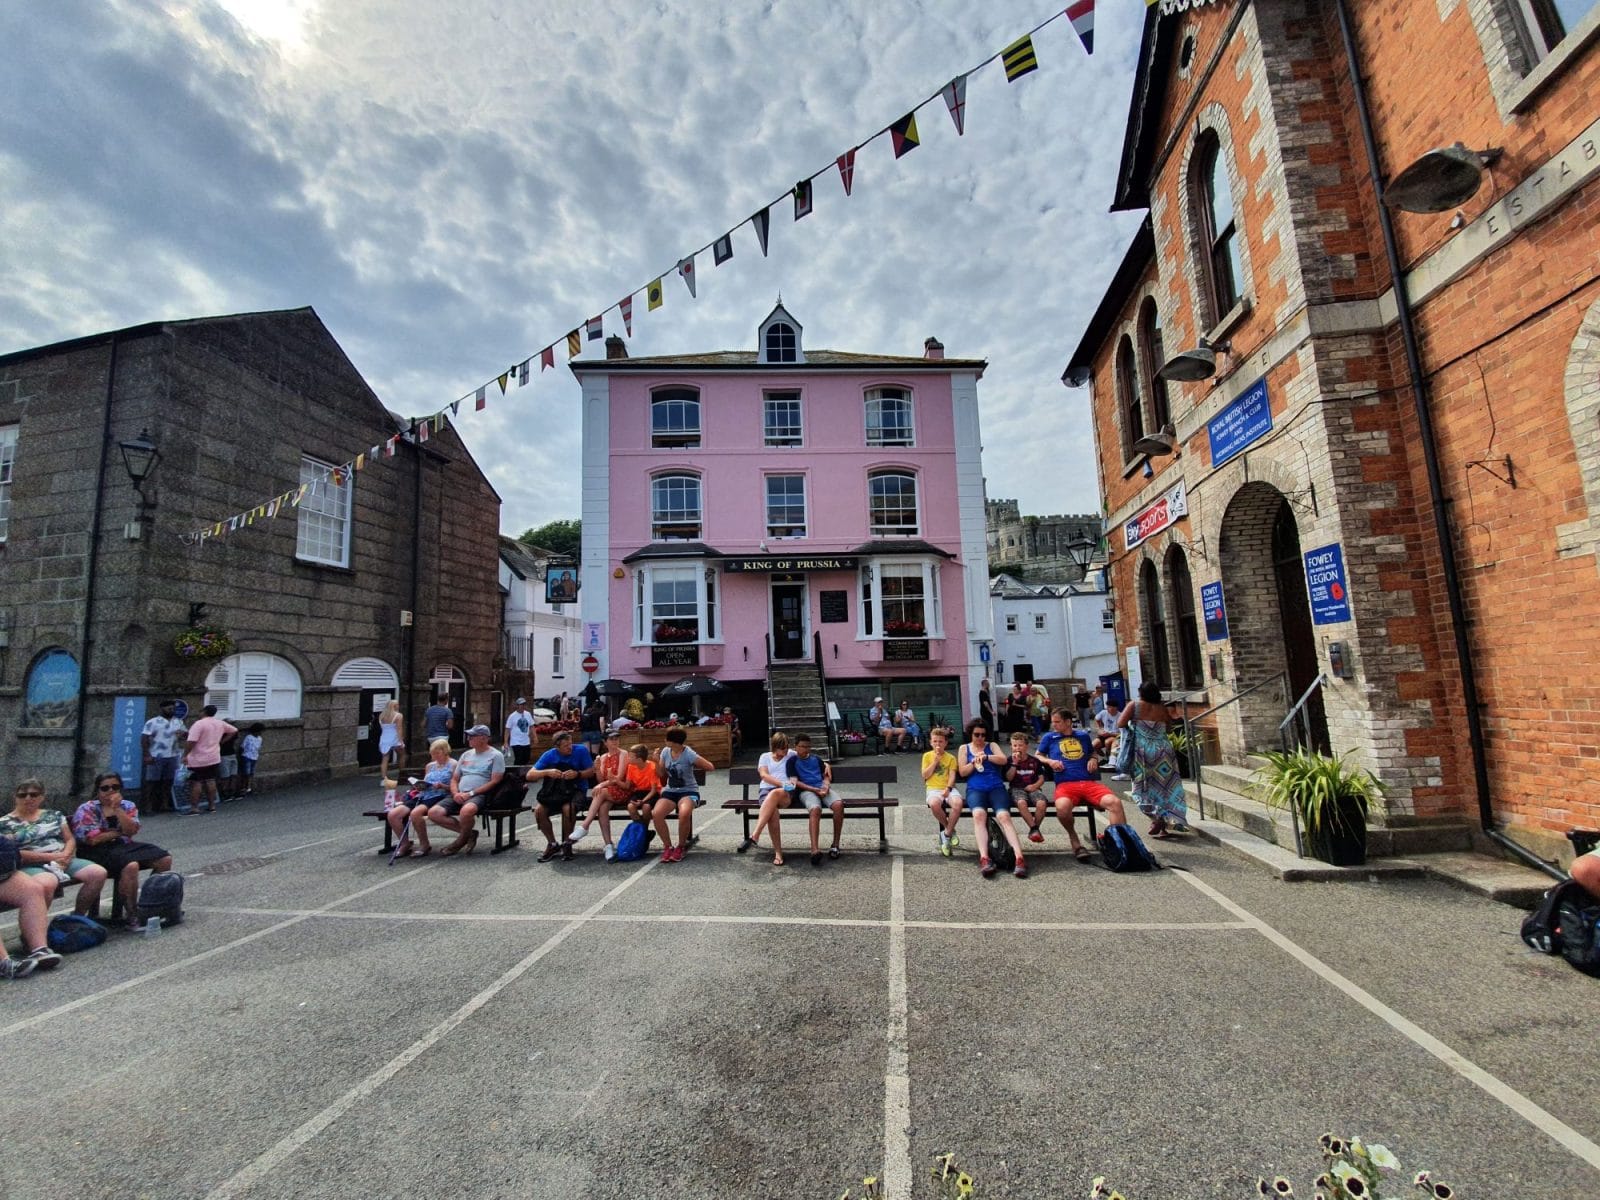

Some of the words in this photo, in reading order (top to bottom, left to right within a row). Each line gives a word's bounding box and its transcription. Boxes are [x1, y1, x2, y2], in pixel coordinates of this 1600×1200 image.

[1212, 418, 1225, 434] ROYAL
[1225, 405, 1243, 423] BRITISH
[1243, 388, 1263, 409] LEGION
[1229, 415, 1246, 432] BRANCH
[1249, 403, 1262, 416] CLUB
[1234, 427, 1243, 436] AND
[1246, 418, 1267, 437] INSTITUTE
[1128, 524, 1139, 540] sky
[1139, 506, 1165, 534] sports
[743, 561, 772, 570] KING
[797, 560, 840, 568] PRUSSIA
[1308, 552, 1333, 567] FOWEY
[1310, 570, 1338, 585] LEGION
[1204, 600, 1220, 609] LEGION
[122, 699, 134, 771] AQUARIUM
